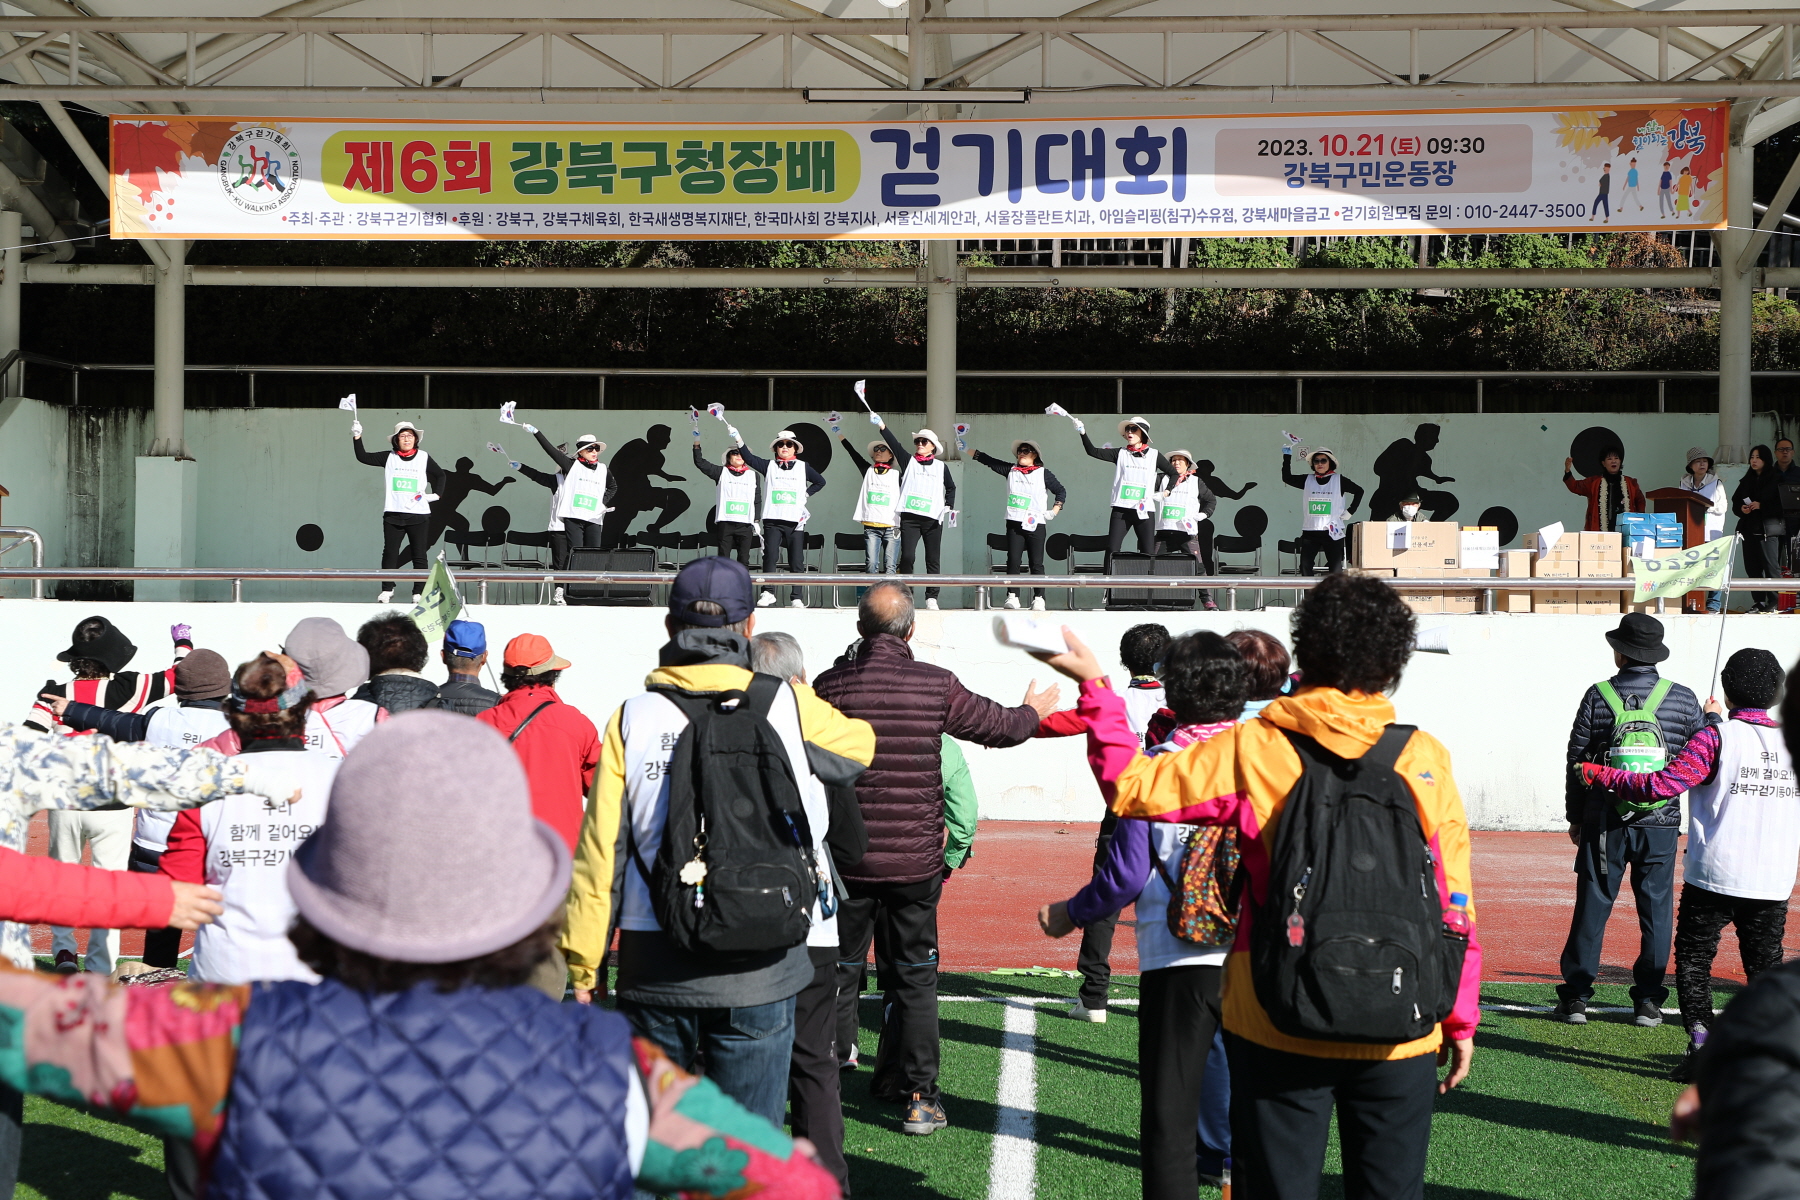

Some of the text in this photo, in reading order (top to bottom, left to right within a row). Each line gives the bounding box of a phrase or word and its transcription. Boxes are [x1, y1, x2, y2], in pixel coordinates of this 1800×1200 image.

[227, 129, 291, 151] 강북구걷기협회
[1667, 118, 1706, 155] 강북
[1258, 134, 1486, 158] 2023. 10.21 (토) 09:30
[343, 139, 836, 195] 제6회 강북구청장배
[870, 125, 1187, 207] 걷기대회
[1284, 160, 1457, 189] 강북구민운동장
[220, 160, 299, 212] GANGBUK-KU WALKING ASSOCIATION
[356, 212, 447, 227] 강북구걷기협회
[458, 212, 484, 227] 후원
[496, 212, 538, 228] 강북구,
[542, 212, 624, 228] 강북구체육회,
[629, 212, 751, 228] 한국새생명복지재단,
[754, 211, 819, 226] 한국마사회
[824, 211, 880, 227] 강북지사,
[885, 211, 980, 227] 서울신세계안과,
[985, 210, 1095, 226] 서울장플란트치과,
[1099, 208, 1237, 225] 아임슬리핑(침구)수유점,
[1242, 207, 1331, 223] 강북새마을금고
[1341, 206, 1421, 222] 걷기회원모집
[1425, 206, 1452, 221] 문의
[1464, 204, 1586, 221] 010-2447-3500
[396, 480, 413, 490] 021
[1125, 488, 1141, 498] 076
[577, 498, 593, 506] 131
[730, 503, 745, 513] 040
[910, 499, 927, 509] 059
[1012, 498, 1027, 507] 048
[1312, 504, 1327, 513] 047
[1166, 508, 1181, 517] 149
[182, 733, 202, 743] 우리
[660, 732, 680, 751] 함
[1760, 751, 1778, 764] 우리
[1740, 766, 1759, 779] 함께
[230, 824, 261, 842] 함께
